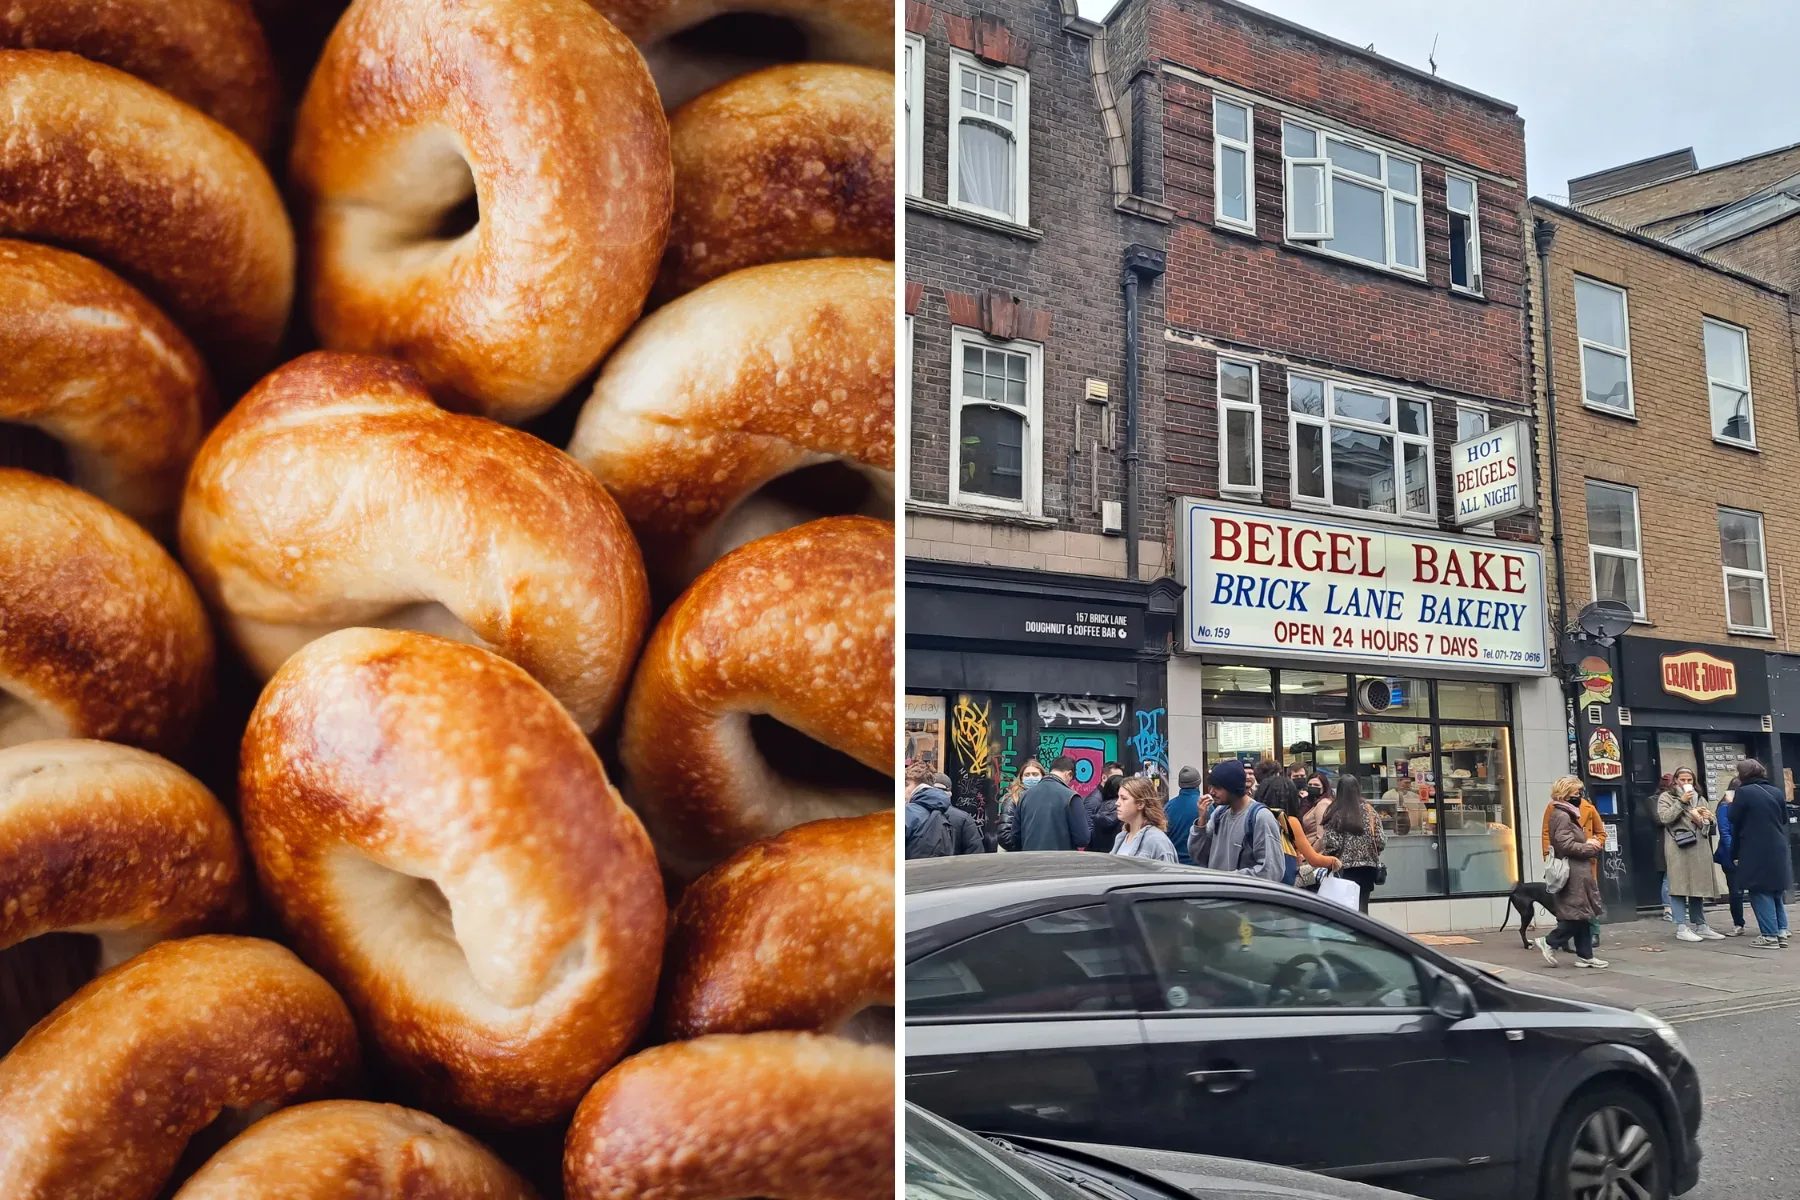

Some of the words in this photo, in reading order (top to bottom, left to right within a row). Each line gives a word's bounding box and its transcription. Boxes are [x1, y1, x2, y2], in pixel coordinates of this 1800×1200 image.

[1467, 437, 1502, 462] HOT
[1456, 456, 1517, 493] BEIGELS
[1459, 496, 1480, 515] ALL
[1483, 484, 1518, 508] NIGHT
[1210, 517, 1386, 578] BEIGEL
[1411, 543, 1527, 594] BAKE
[1211, 572, 1310, 612] BRICK
[1324, 584, 1404, 620] LANE
[1418, 594, 1527, 631] BAKERY
[1025, 621, 1066, 634] DOUGHNUT
[1067, 624, 1072, 635] &
[1074, 625, 1100, 637] COFFEE
[1102, 628, 1116, 638] BAR
[1076, 612, 1088, 622] 157
[1090, 613, 1109, 624] BRICK
[1110, 615, 1127, 626] LANE
[1274, 620, 1324, 645] OPEN
[1332, 626, 1353, 648] 24
[1361, 628, 1419, 653] HOURS
[1425, 634, 1434, 654] 7
[1440, 635, 1478, 658] DAYS
[1525, 652, 1541, 662] 0616
[1665, 661, 1700, 691] CRAVE
[1702, 662, 1732, 692] JOINT
[921, 701, 939, 714] day
[1590, 762, 1606, 775] CRAVE
